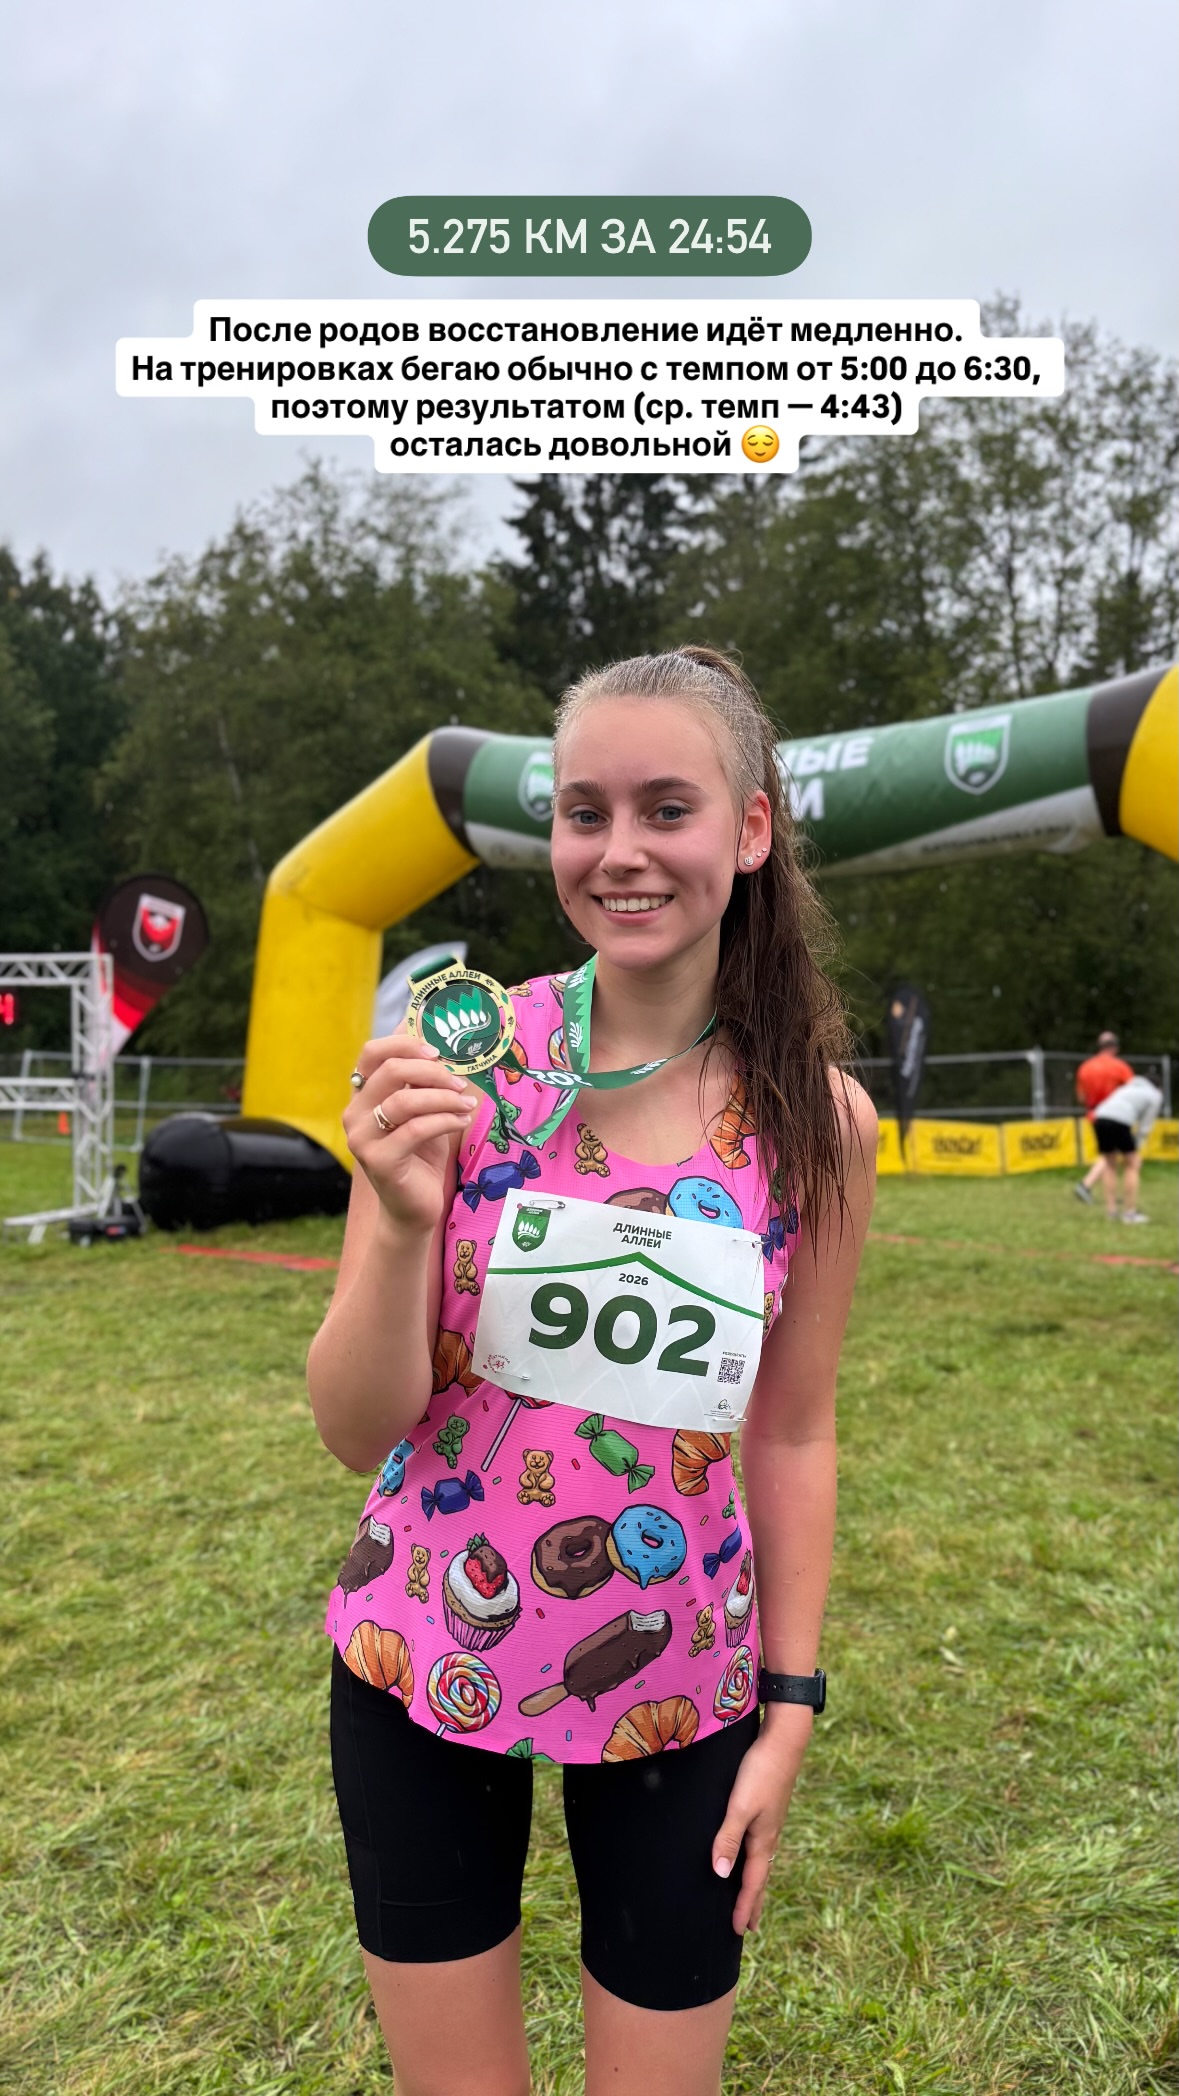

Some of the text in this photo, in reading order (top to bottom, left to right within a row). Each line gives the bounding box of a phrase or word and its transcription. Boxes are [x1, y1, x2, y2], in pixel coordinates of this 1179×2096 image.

[411, 970, 482, 1010] ДЛИННЫЕ АЛЛЕИ
[467, 1054, 498, 1073] ГАТЧИНА
[612, 1222, 673, 1240] ДЛИННЫЕ
[620, 1234, 662, 1249] АЛЛЕИ
[618, 1272, 650, 1286] 2026
[528, 1282, 717, 1378] 902
